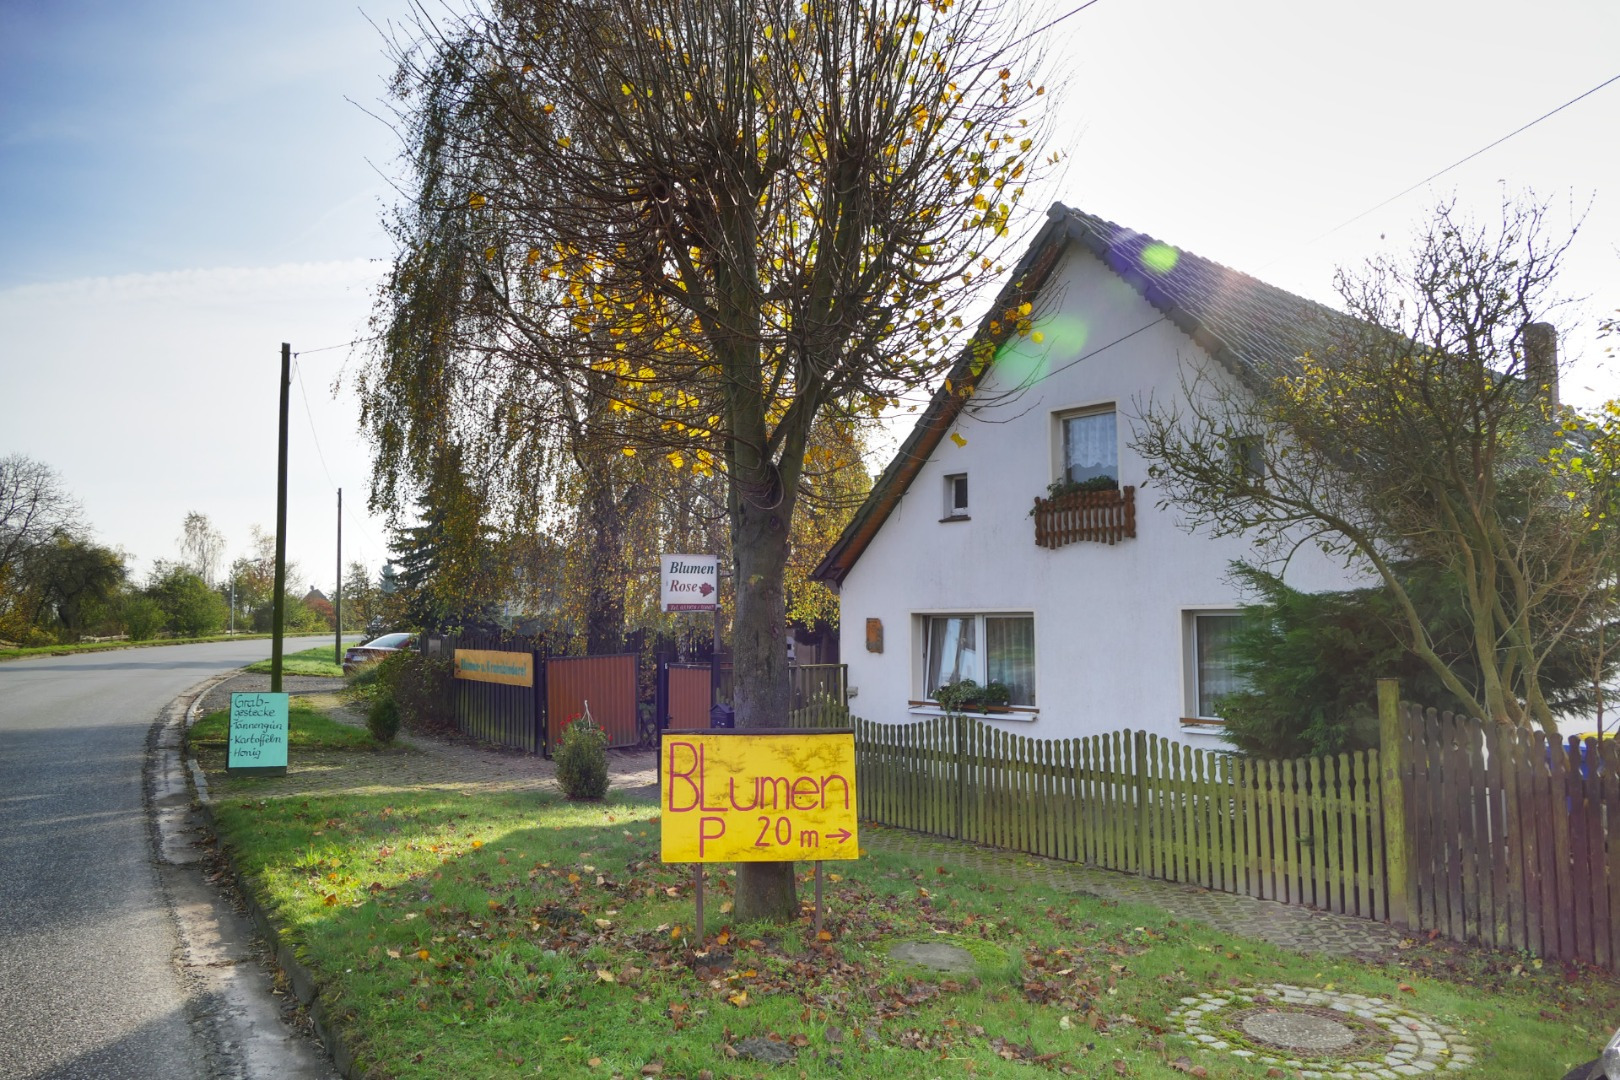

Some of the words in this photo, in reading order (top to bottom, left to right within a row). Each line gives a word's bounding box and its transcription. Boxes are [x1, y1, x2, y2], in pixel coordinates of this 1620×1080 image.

[669, 561, 714, 575] Blumen
[669, 579, 698, 592] Rose
[234, 694, 270, 708] Grab-
[234, 706, 276, 721] gestecke
[233, 747, 261, 759] Honig
[699, 816, 726, 858] P
[755, 816, 792, 847] 20
[800, 830, 819, 848] m
